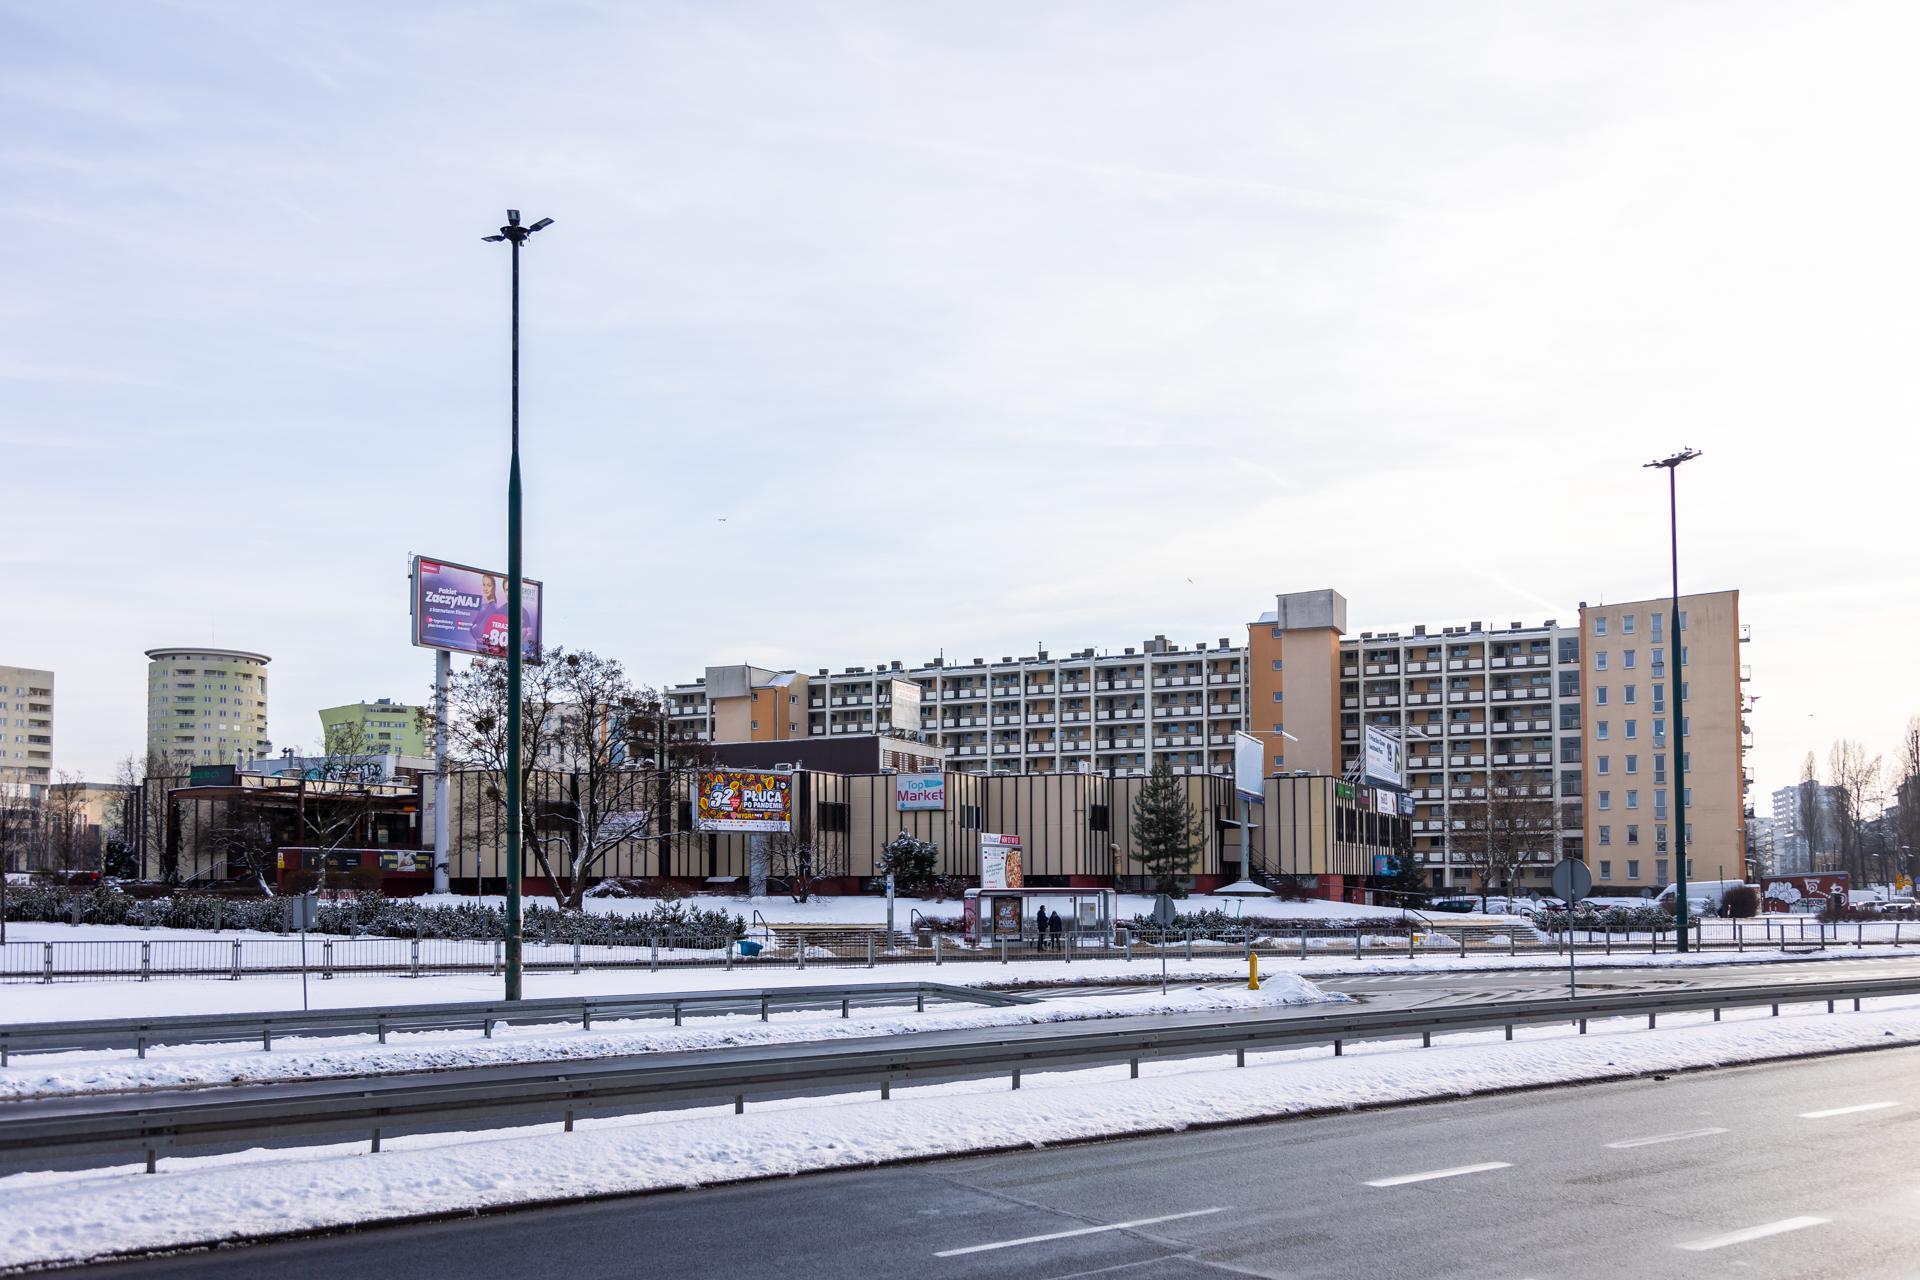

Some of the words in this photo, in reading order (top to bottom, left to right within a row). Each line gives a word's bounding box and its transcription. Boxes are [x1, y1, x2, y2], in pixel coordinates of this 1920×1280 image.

[438, 587, 457, 595] Pakiet
[425, 591, 480, 609] ZaczyNAJ
[492, 621, 509, 630] TERAZ
[489, 629, 509, 647] 80
[906, 780, 924, 791] Top
[710, 786, 735, 808] 32
[743, 789, 782, 803] PŁUCA
[897, 789, 944, 801] Market
[753, 801, 783, 809] PANDEMII
